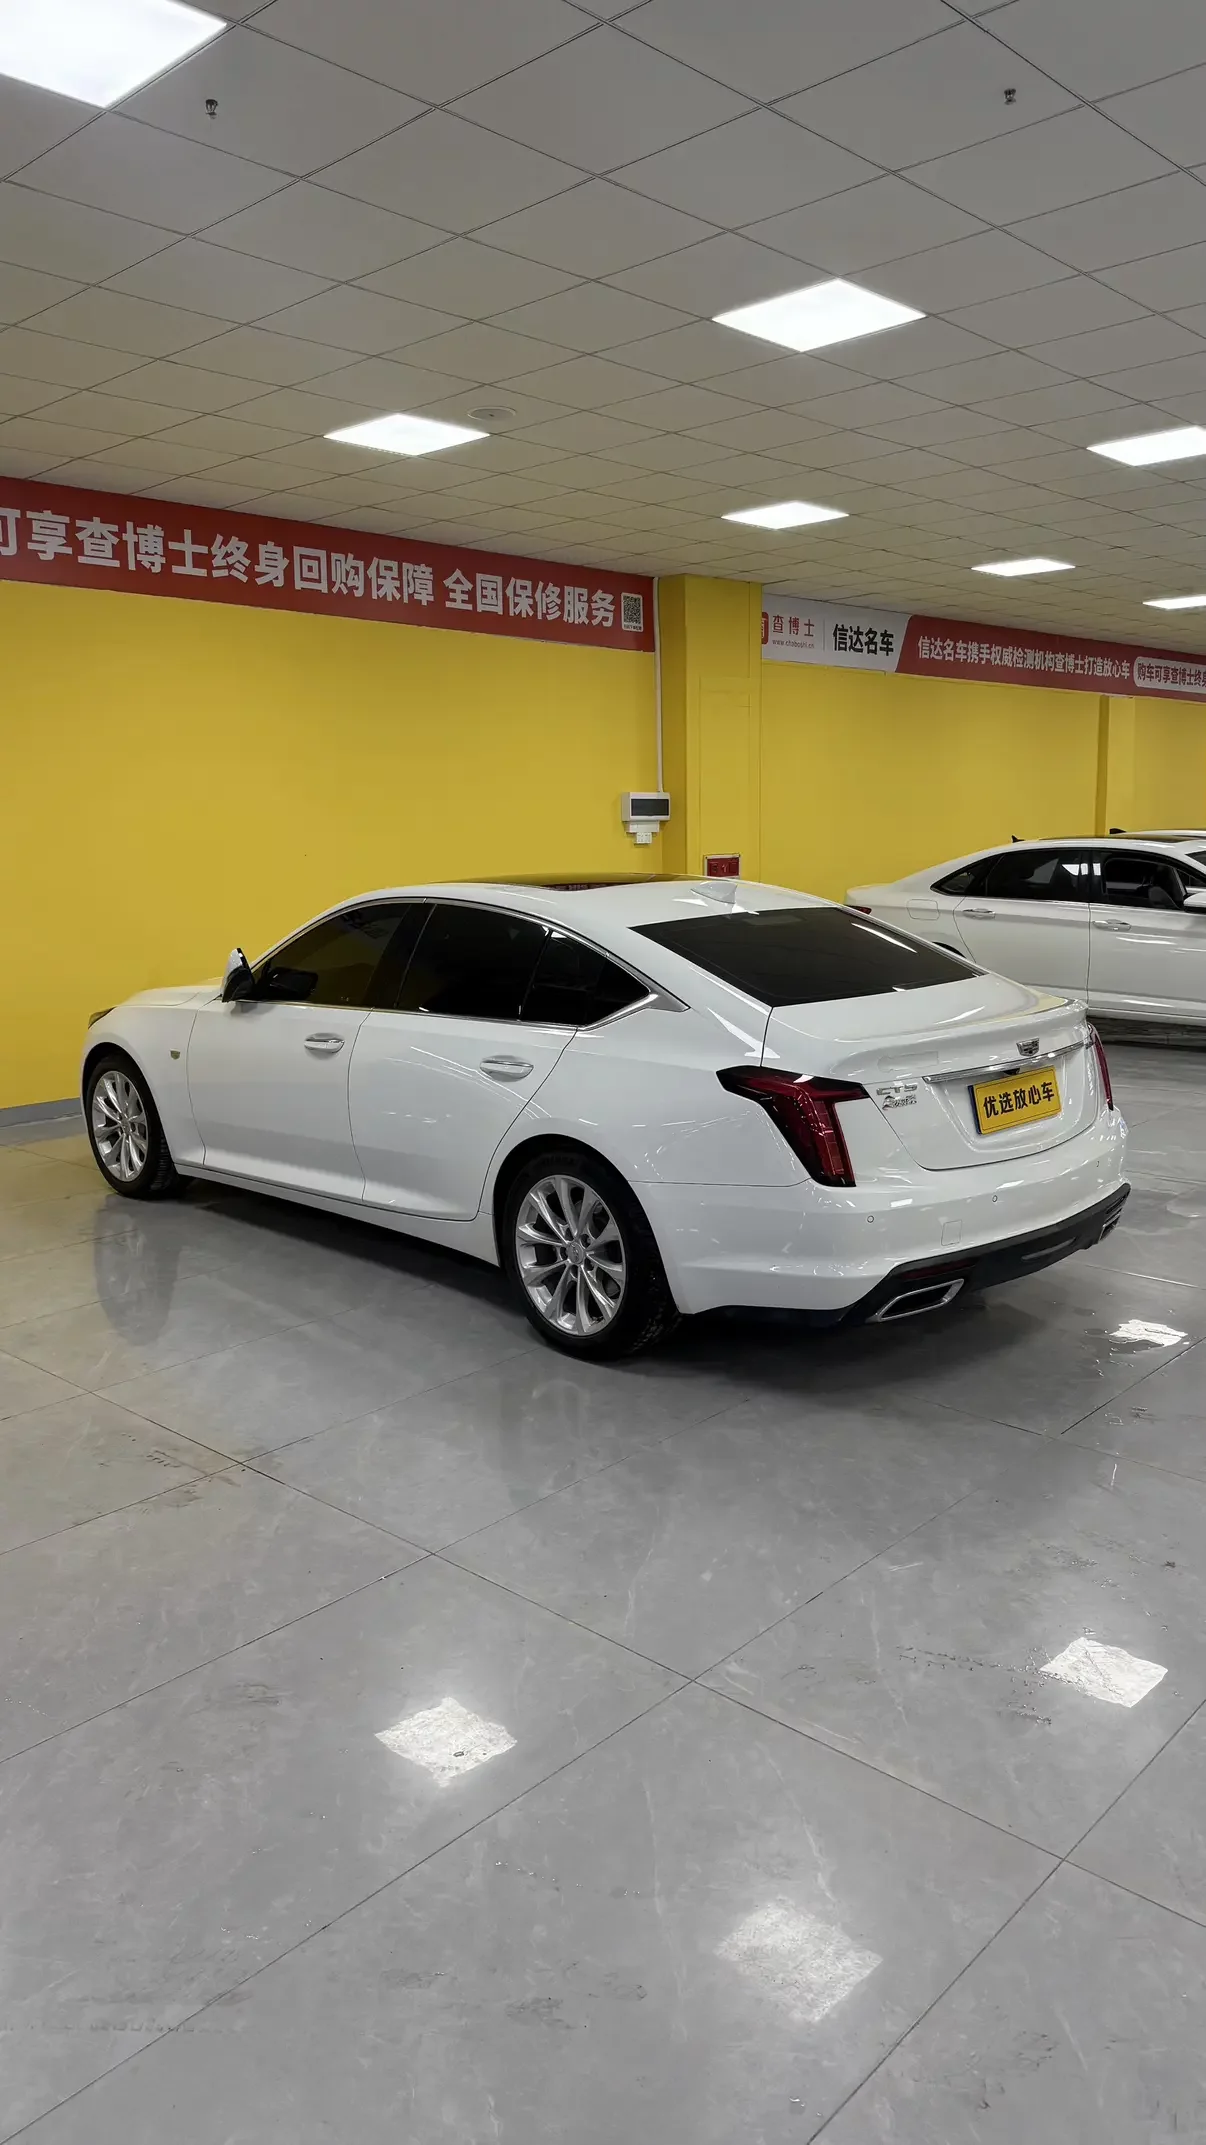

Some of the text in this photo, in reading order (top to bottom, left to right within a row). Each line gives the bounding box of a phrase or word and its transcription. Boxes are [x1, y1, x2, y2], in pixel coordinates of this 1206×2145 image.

[443, 568, 616, 628] 全国保修服务
[772, 614, 815, 637] 查博士
[832, 623, 894, 656] 信达名车
[917, 635, 1130, 680] 信达名车携手权威检测机构查博士打造放心车
[983, 1081, 1055, 1119] 优选放心车
